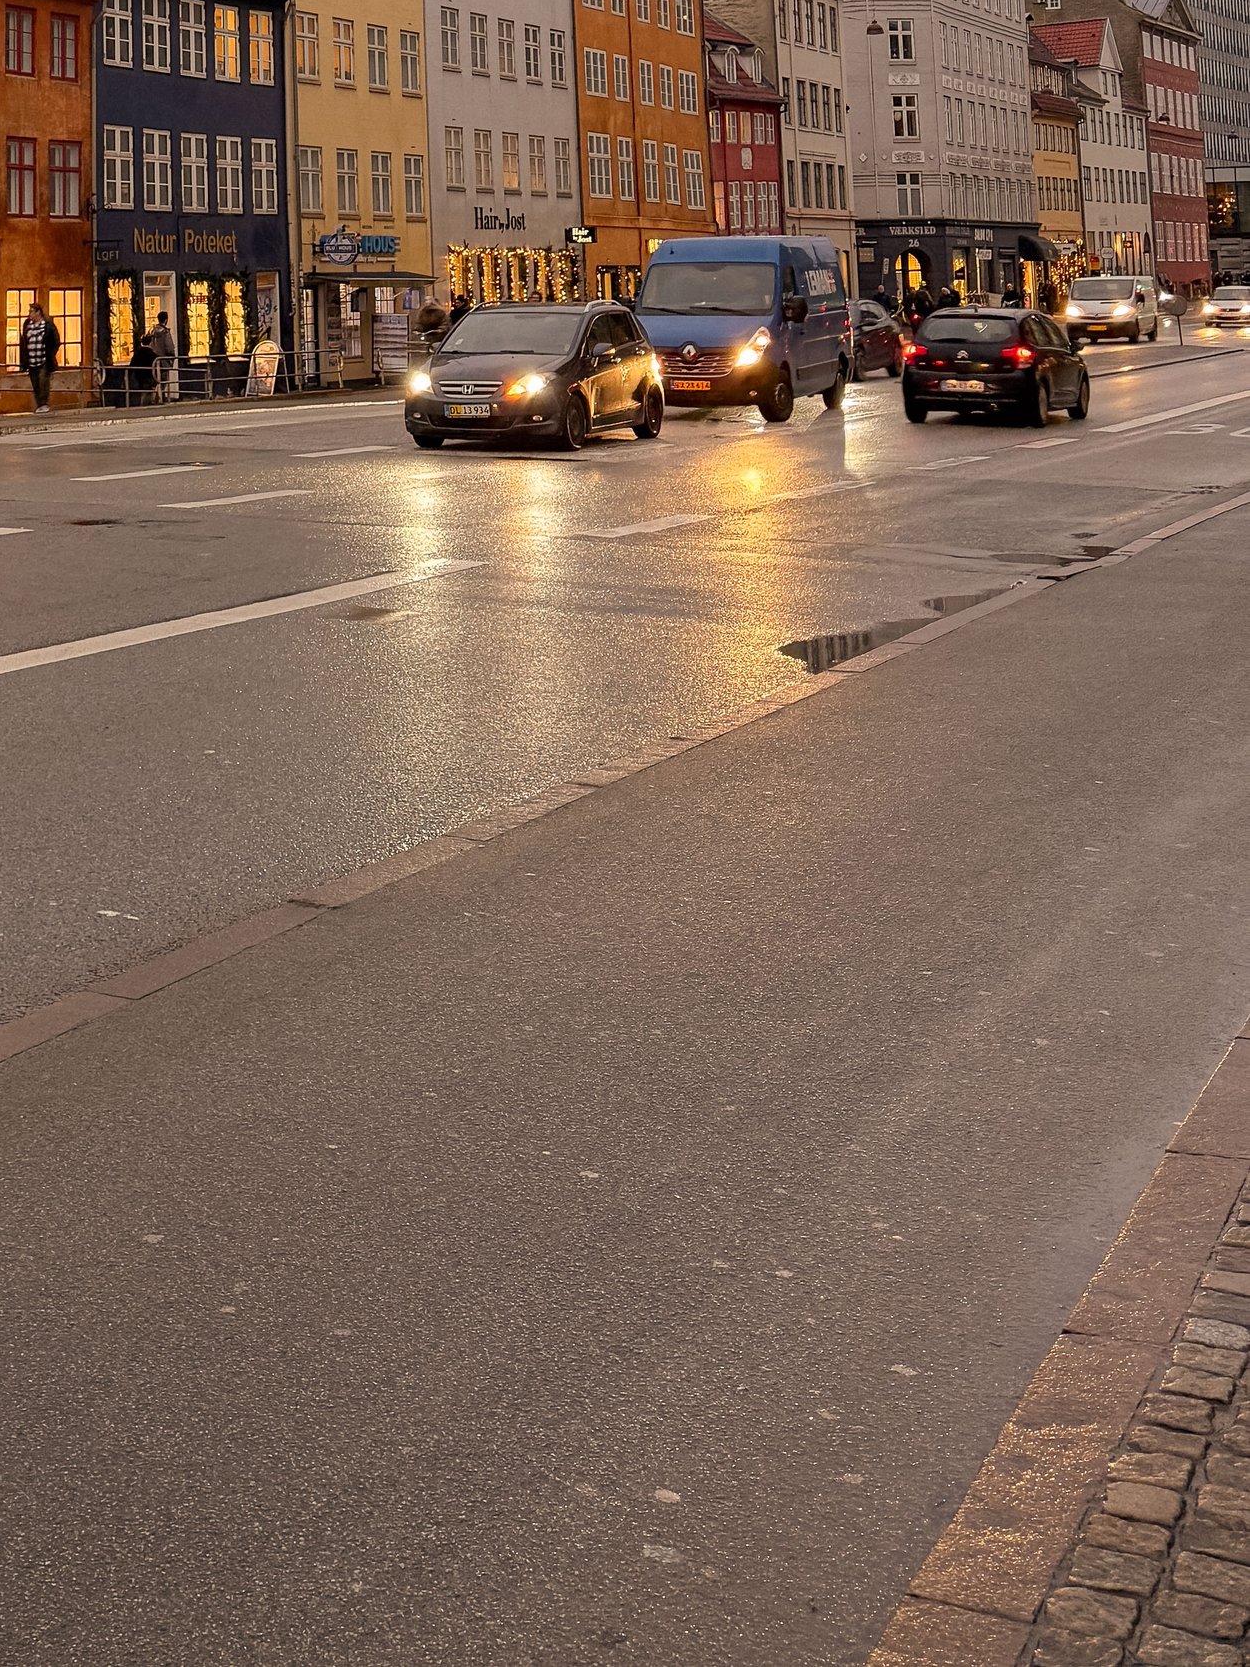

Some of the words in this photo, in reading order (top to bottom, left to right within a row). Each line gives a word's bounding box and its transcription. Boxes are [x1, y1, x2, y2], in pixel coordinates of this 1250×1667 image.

[474, 206, 499, 230] Hair
[505, 207, 526, 231] Jost
[133, 227, 176, 254] Natur
[184, 228, 238, 254] Poteket
[908, 239, 920, 248] 26
[96, 250, 119, 261] LOFT
[449, 406, 461, 415] DL
[463, 406, 472, 415] 13
[473, 406, 489, 415] 934
